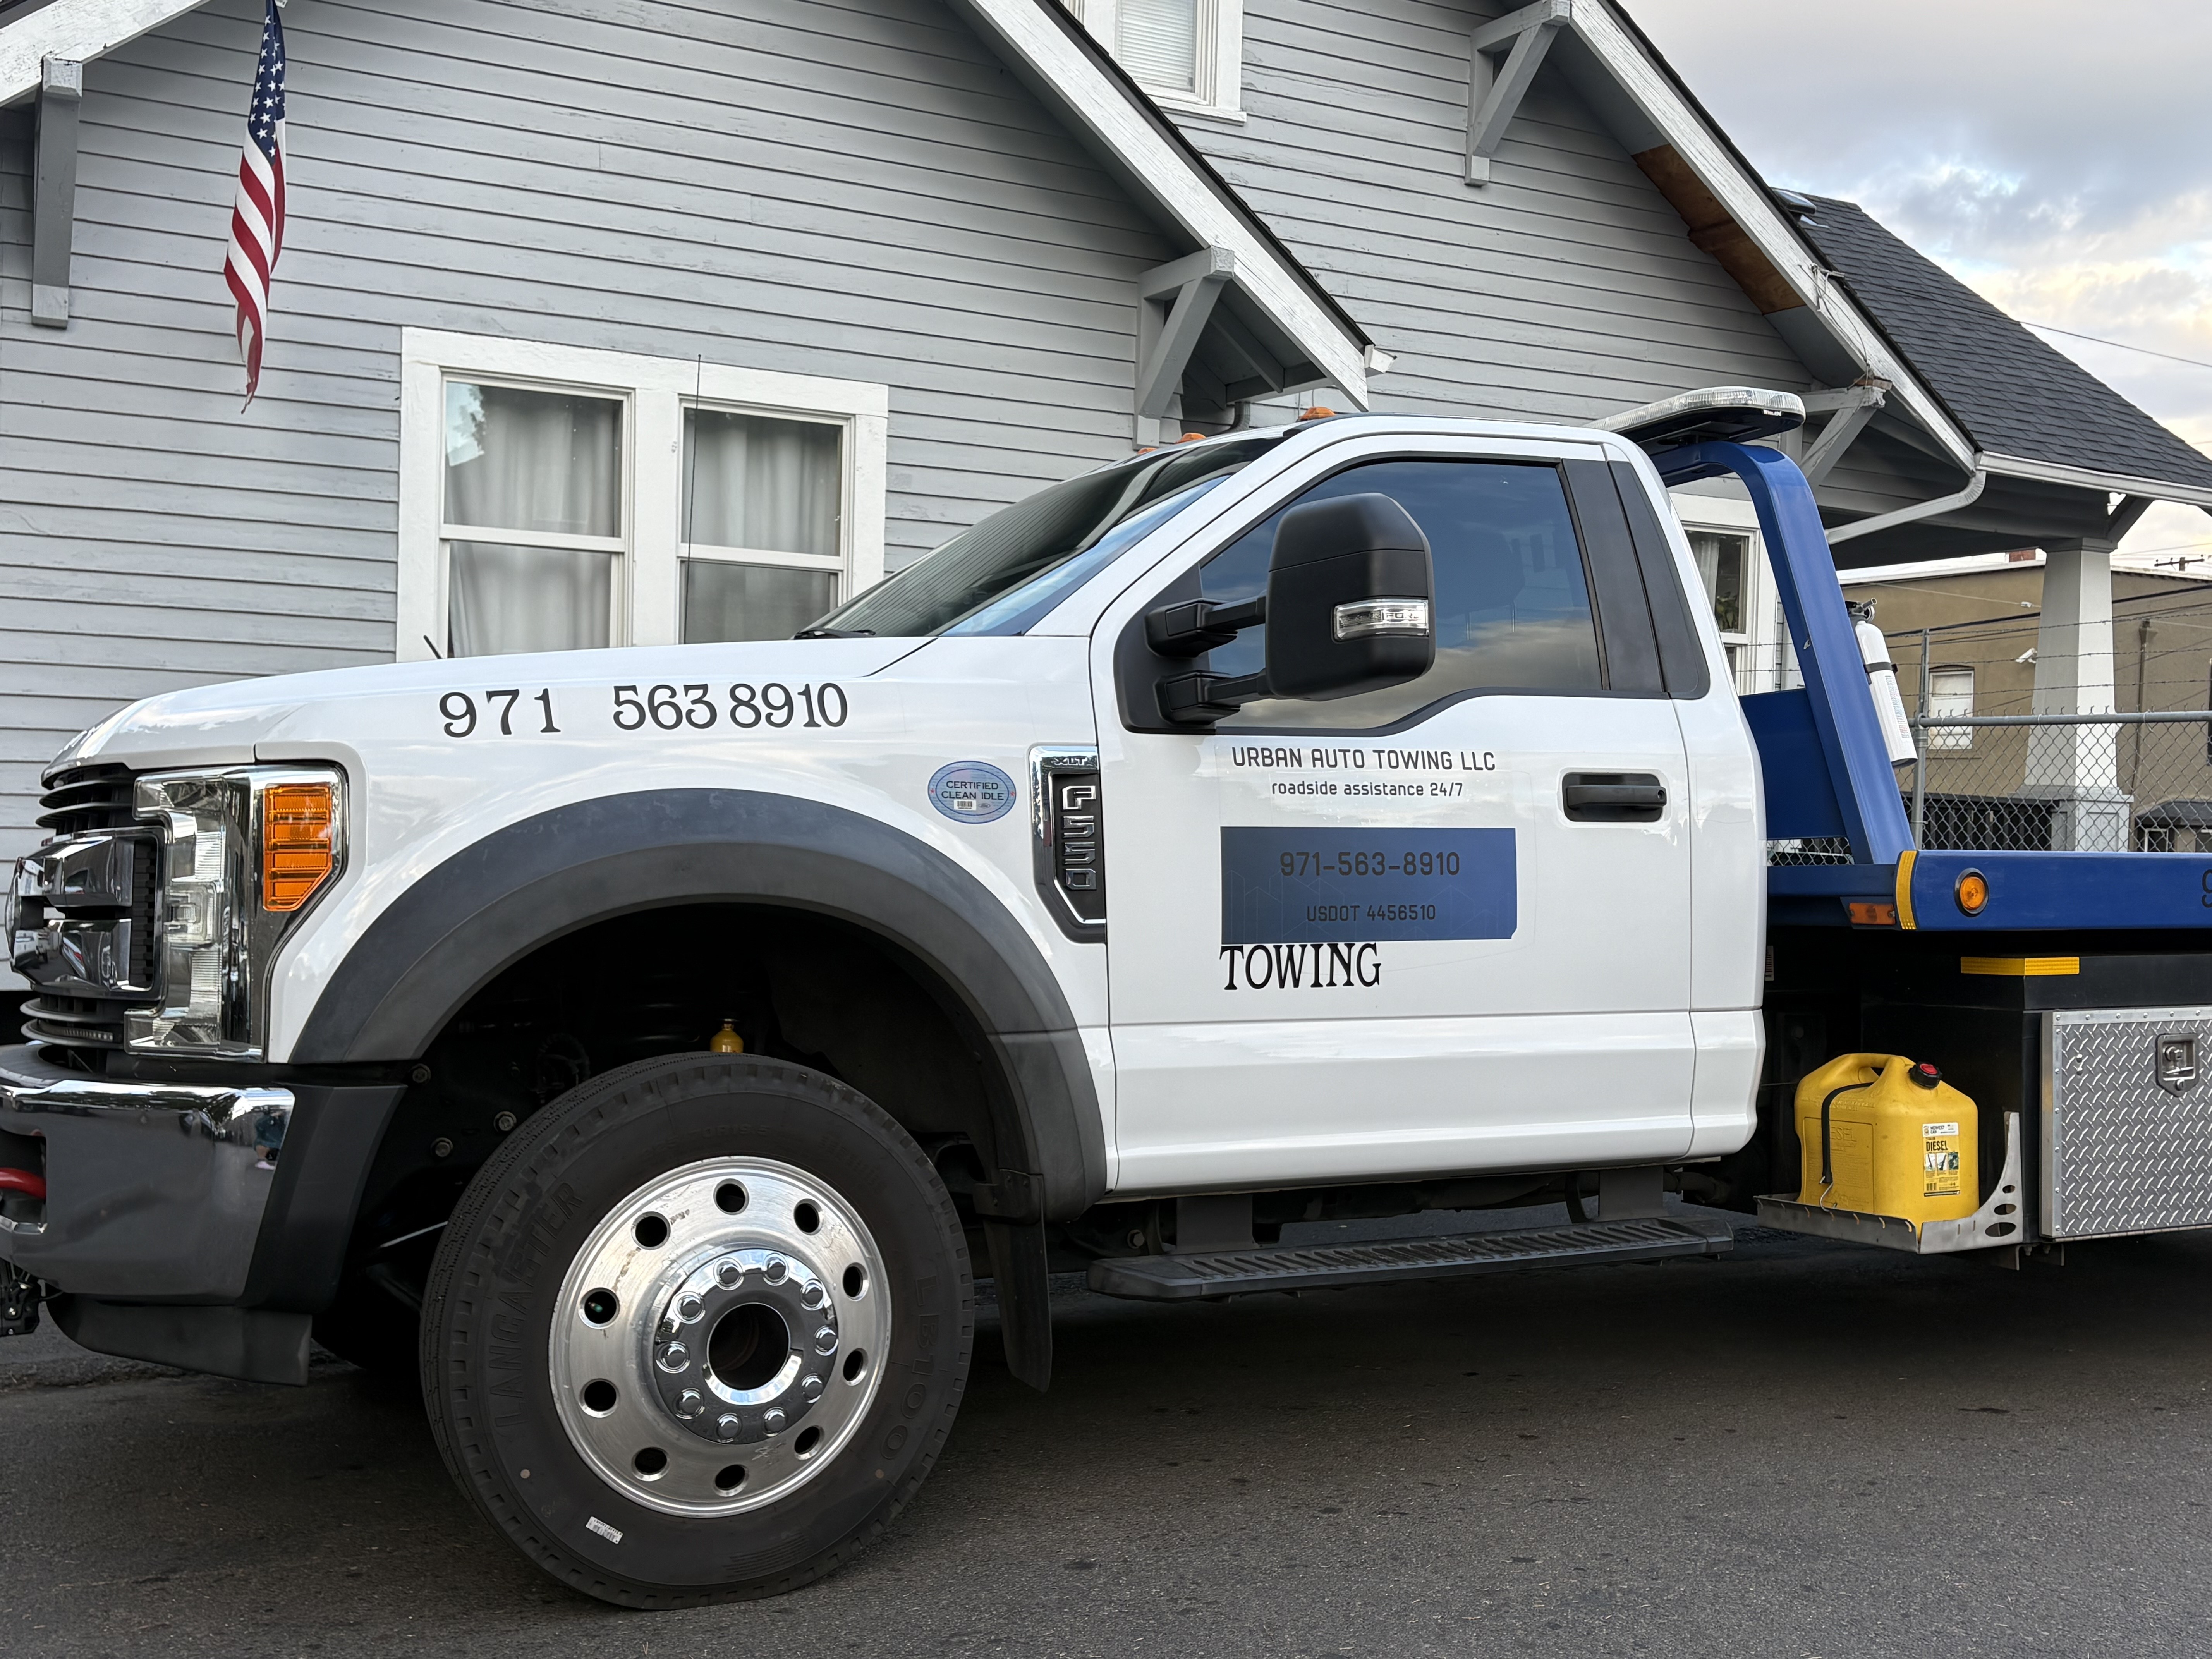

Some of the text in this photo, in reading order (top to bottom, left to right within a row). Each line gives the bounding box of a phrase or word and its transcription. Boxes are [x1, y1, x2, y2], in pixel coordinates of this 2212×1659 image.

[438, 682, 848, 738] 971 563 8910
[1232, 747, 1496, 771] URBAN AUTO TOWING LLC
[941, 791, 1004, 800] CLEAN IDLE
[946, 781, 999, 790] CERTIFIED
[1271, 780, 1463, 797] roadside assistance 24/7
[1061, 785, 1097, 891] F550
[1279, 852, 1460, 876] 971-563-8910
[1306, 904, 1436, 922] USDOT 4456510
[1219, 942, 1382, 991] TOWING
[1926, 1140, 1948, 1151] DIESEL
[488, 1181, 584, 1428] LANCASTER
[880, 1274, 941, 1460] LB100
